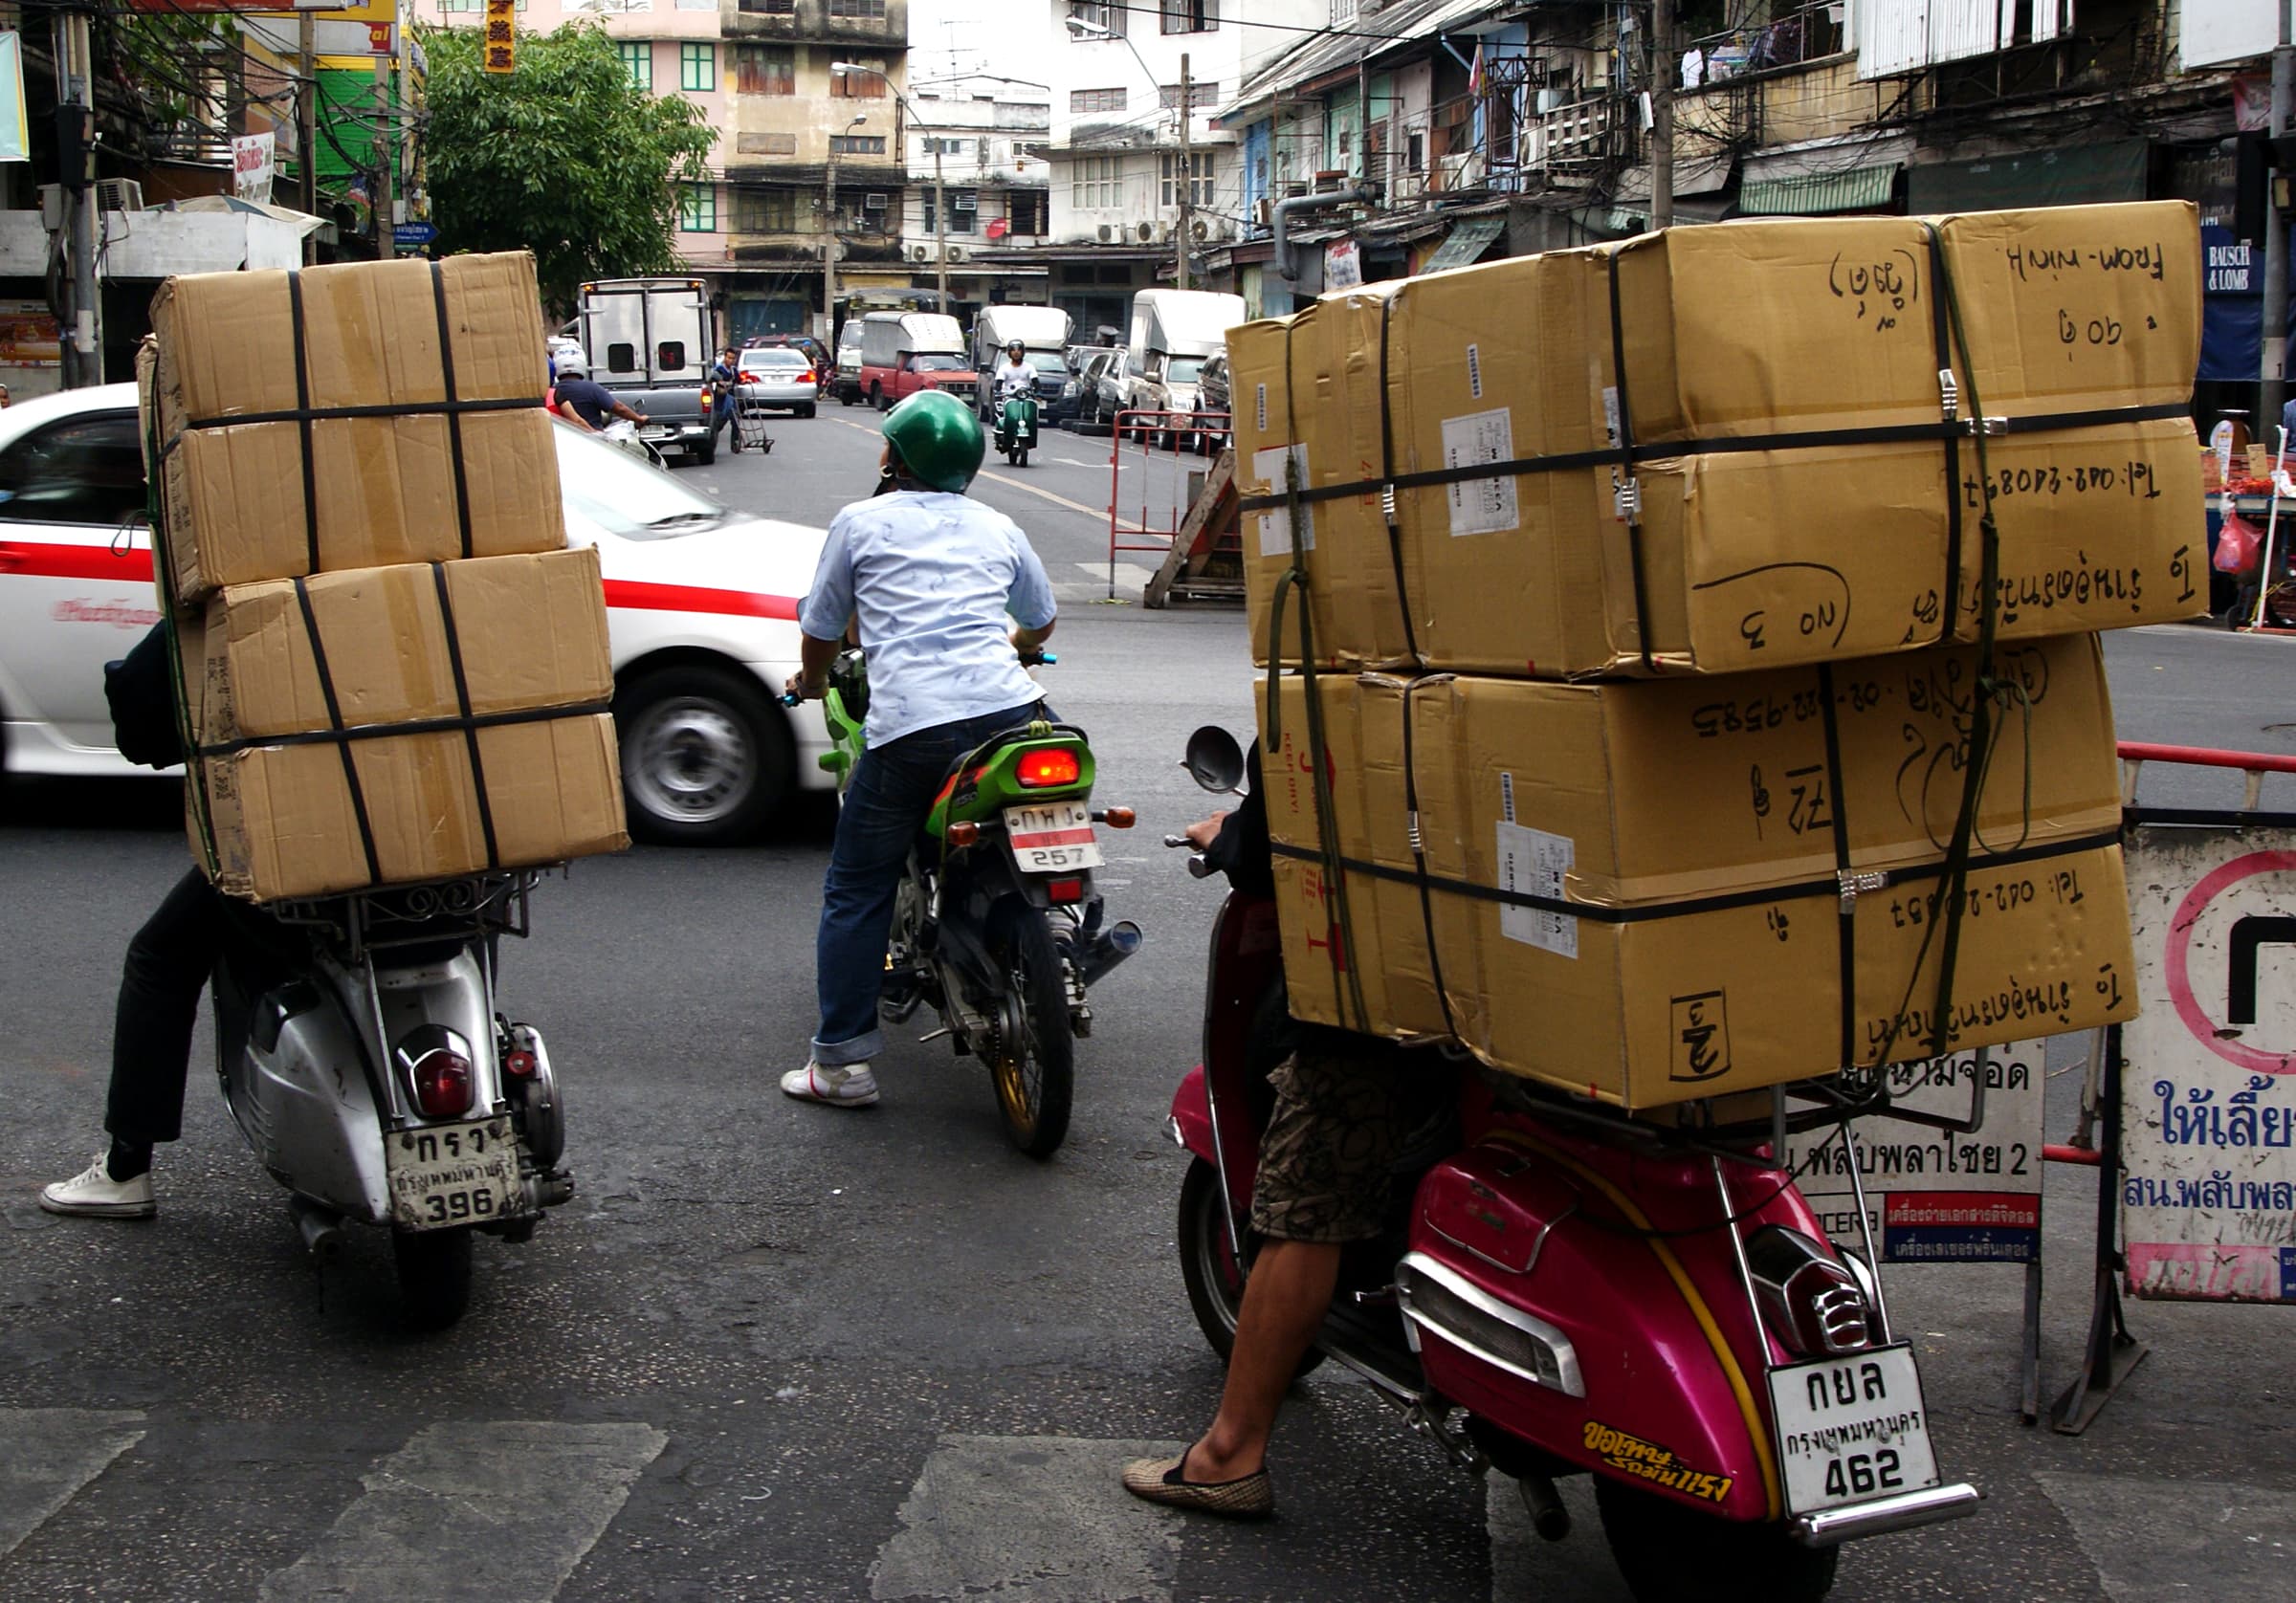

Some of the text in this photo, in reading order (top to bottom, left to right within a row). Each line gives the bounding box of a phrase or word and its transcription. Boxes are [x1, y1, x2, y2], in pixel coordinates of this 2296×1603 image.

[2209, 246, 2250, 267] BAUSCH
[2208, 269, 2249, 291] & LOMB
[1030, 847, 1084, 866] 257
[2153, 1075, 2296, 1148] ให้เลี้ย
[2010, 1143, 2028, 1175] 2
[426, 1187, 494, 1223] 396
[2124, 1170, 2296, 1211] สน.พลับพล
[1806, 1362, 1887, 1412] กยล
[1824, 1448, 1904, 1497] 462
